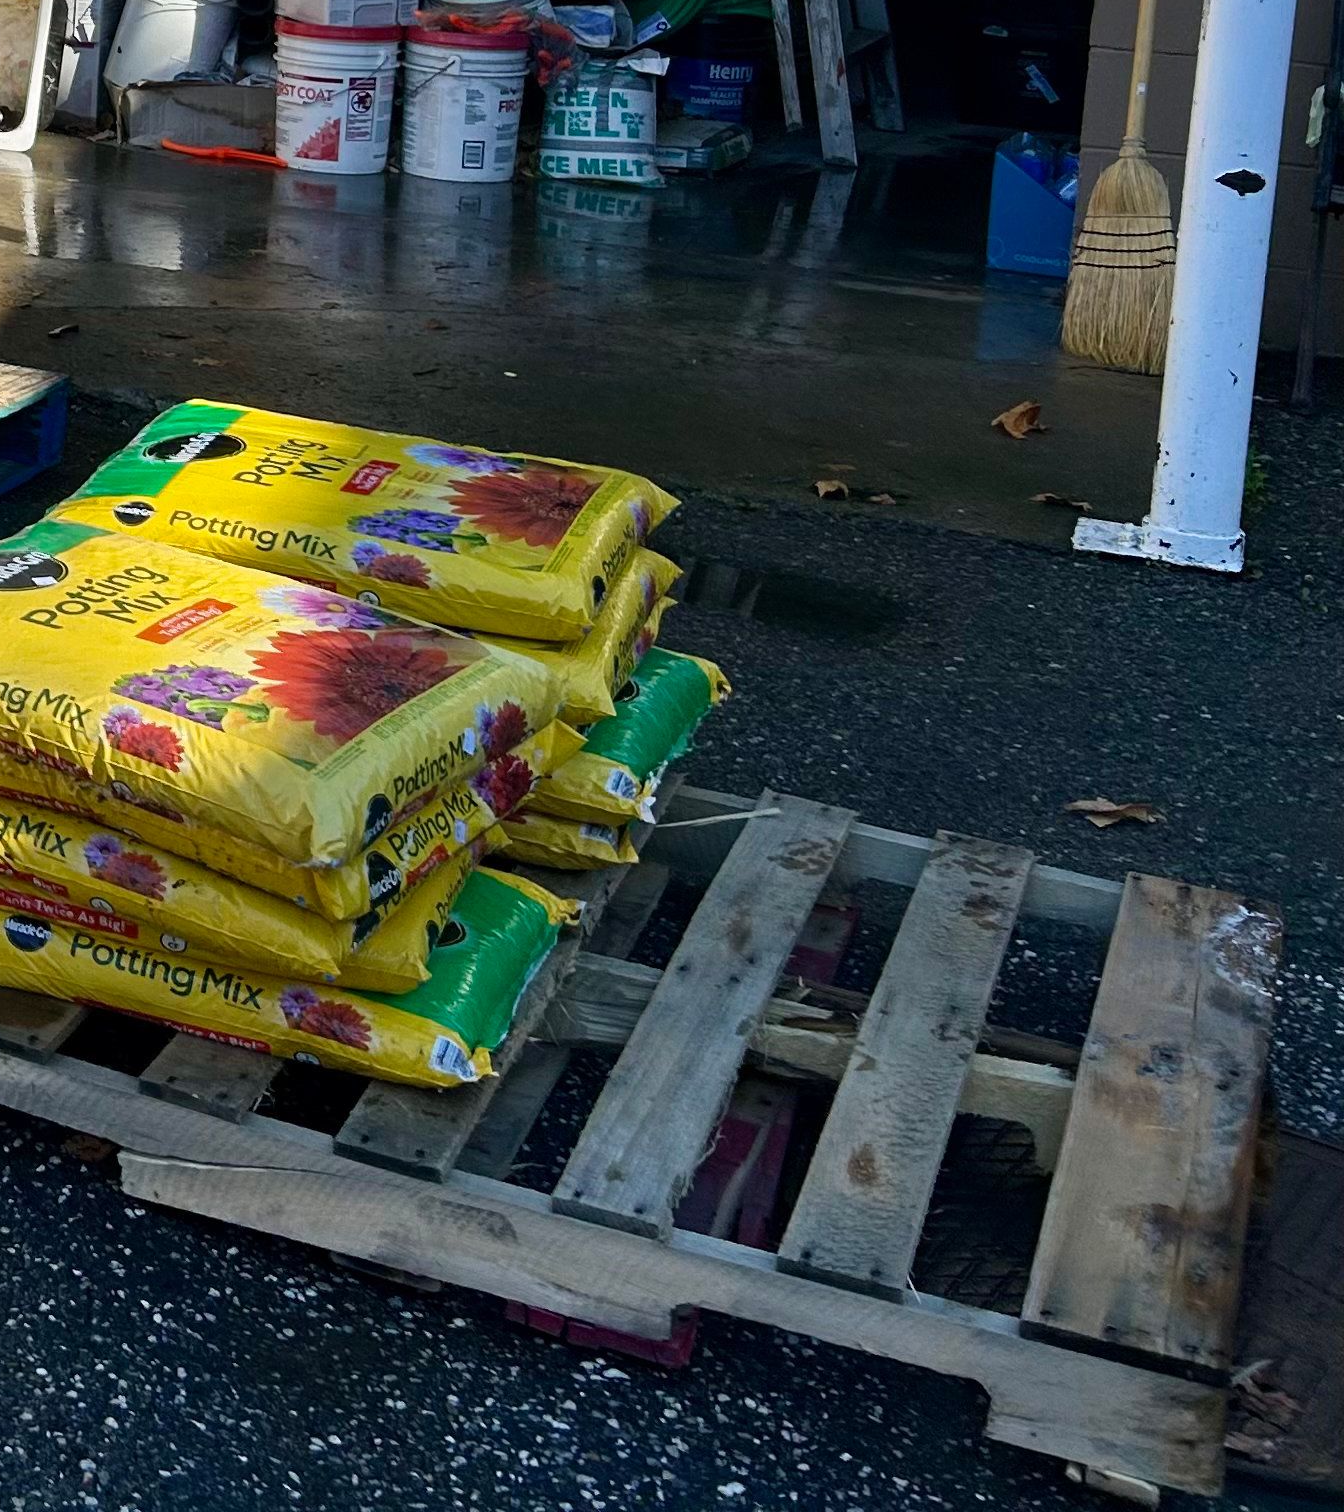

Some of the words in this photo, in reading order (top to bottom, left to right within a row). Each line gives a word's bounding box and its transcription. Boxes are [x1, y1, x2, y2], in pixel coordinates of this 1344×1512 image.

[710, 64, 753, 82] Henry
[299, 85, 334, 99] COAT
[553, 90, 628, 108] CLEAN
[544, 109, 647, 138] MELT
[577, 157, 649, 176] MELT
[233, 438, 329, 486] Potting
[291, 454, 350, 482] Mix
[169, 510, 280, 551] Potting
[283, 531, 340, 561] Mix
[21, 563, 170, 629] Potting
[94, 589, 184, 624] Mix
[32, 688, 93, 729] Mix
[393, 753, 448, 804] Potting
[442, 788, 478, 821] Mix
[15, 814, 72, 857] Mix
[35, 898, 74, 918] Twice
[79, 910, 96, 924] As
[99, 917, 126, 933] Big!
[70, 933, 195, 996] Potting
[202, 967, 265, 1009] Mix
